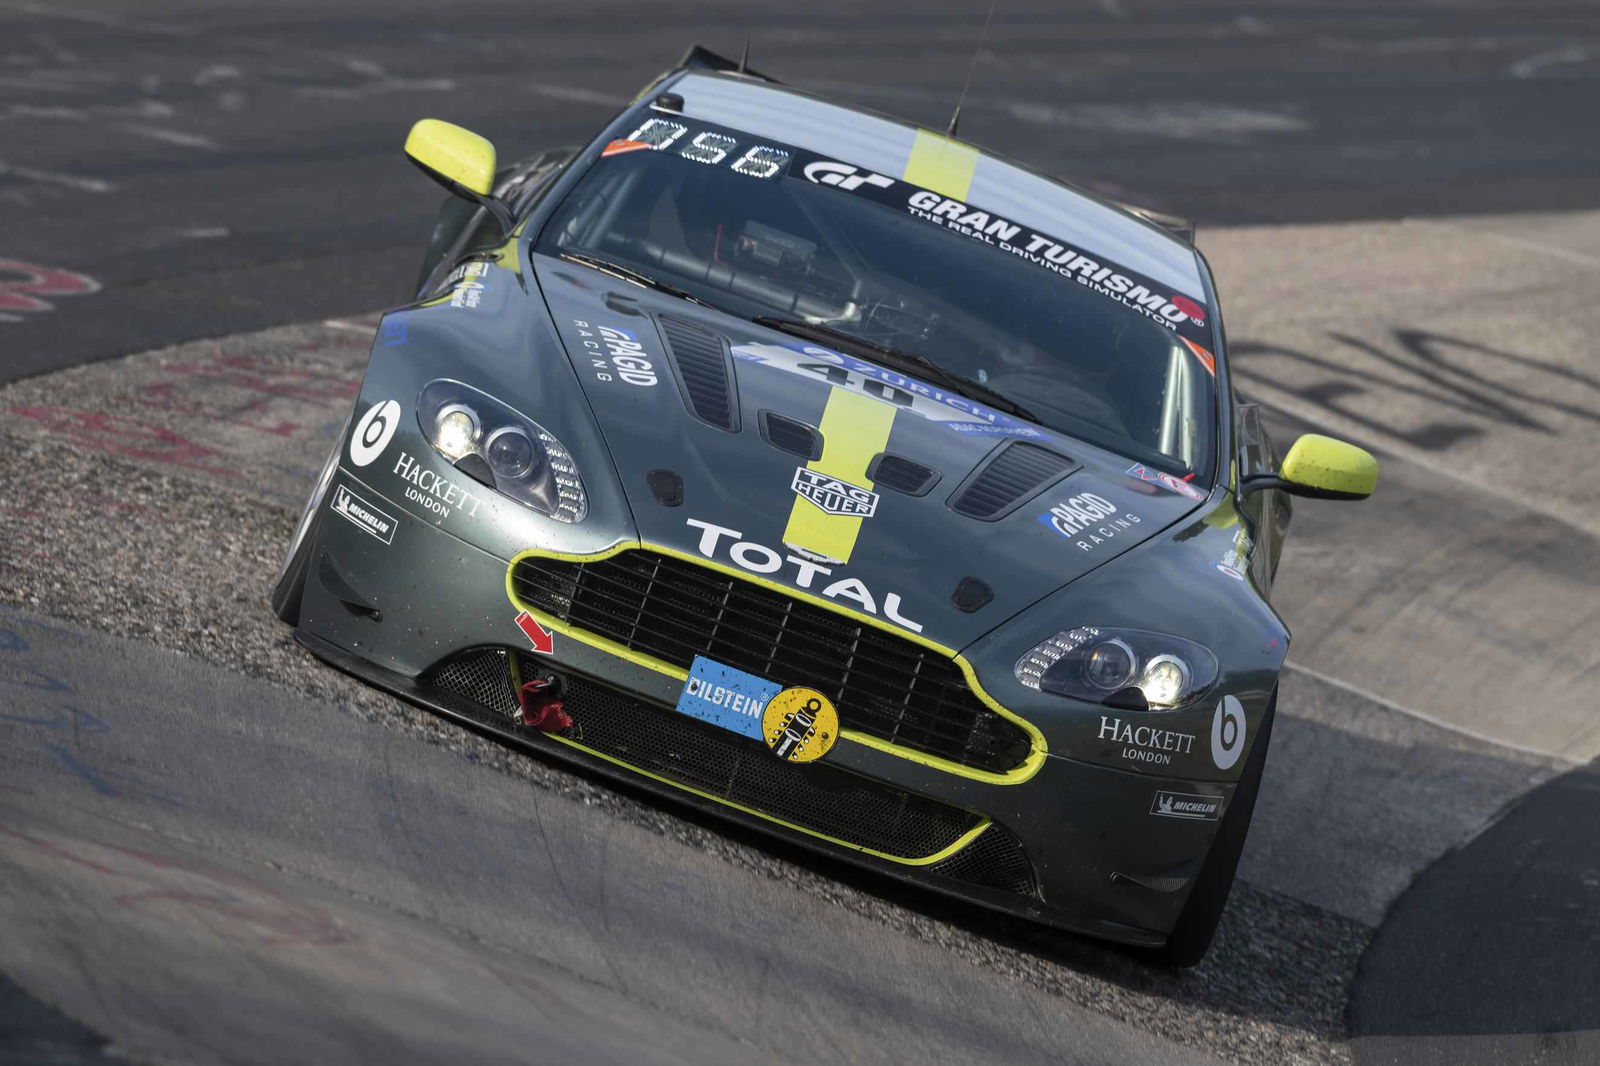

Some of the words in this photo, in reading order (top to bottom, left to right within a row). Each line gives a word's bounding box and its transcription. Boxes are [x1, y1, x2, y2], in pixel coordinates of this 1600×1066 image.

[907, 206, 944, 225] THE
[948, 221, 995, 245] REAL
[999, 241, 1072, 278] DRIVING
[1076, 276, 1177, 331] SIMULATOR
[908, 190, 1022, 241] GRAN
[1025, 234, 1189, 323] TURISMO
[573, 319, 612, 382] RACING
[602, 335, 658, 387] PAGID
[854, 362, 995, 422] ZURICH
[393, 452, 487, 517] HACKETT
[405, 487, 450, 519] LONDON
[797, 482, 870, 514] HEUER
[801, 470, 872, 503] TAG
[348, 503, 389, 534] MICHELIN
[1050, 492, 1117, 532] PAGID
[1077, 513, 1142, 552] RACING
[686, 518, 923, 633] TOTAL
[686, 677, 764, 719] BILSTEIN
[1098, 716, 1196, 754] HACKETT
[1122, 747, 1171, 765] LONDON
[1173, 801, 1217, 813] MICHELIN
